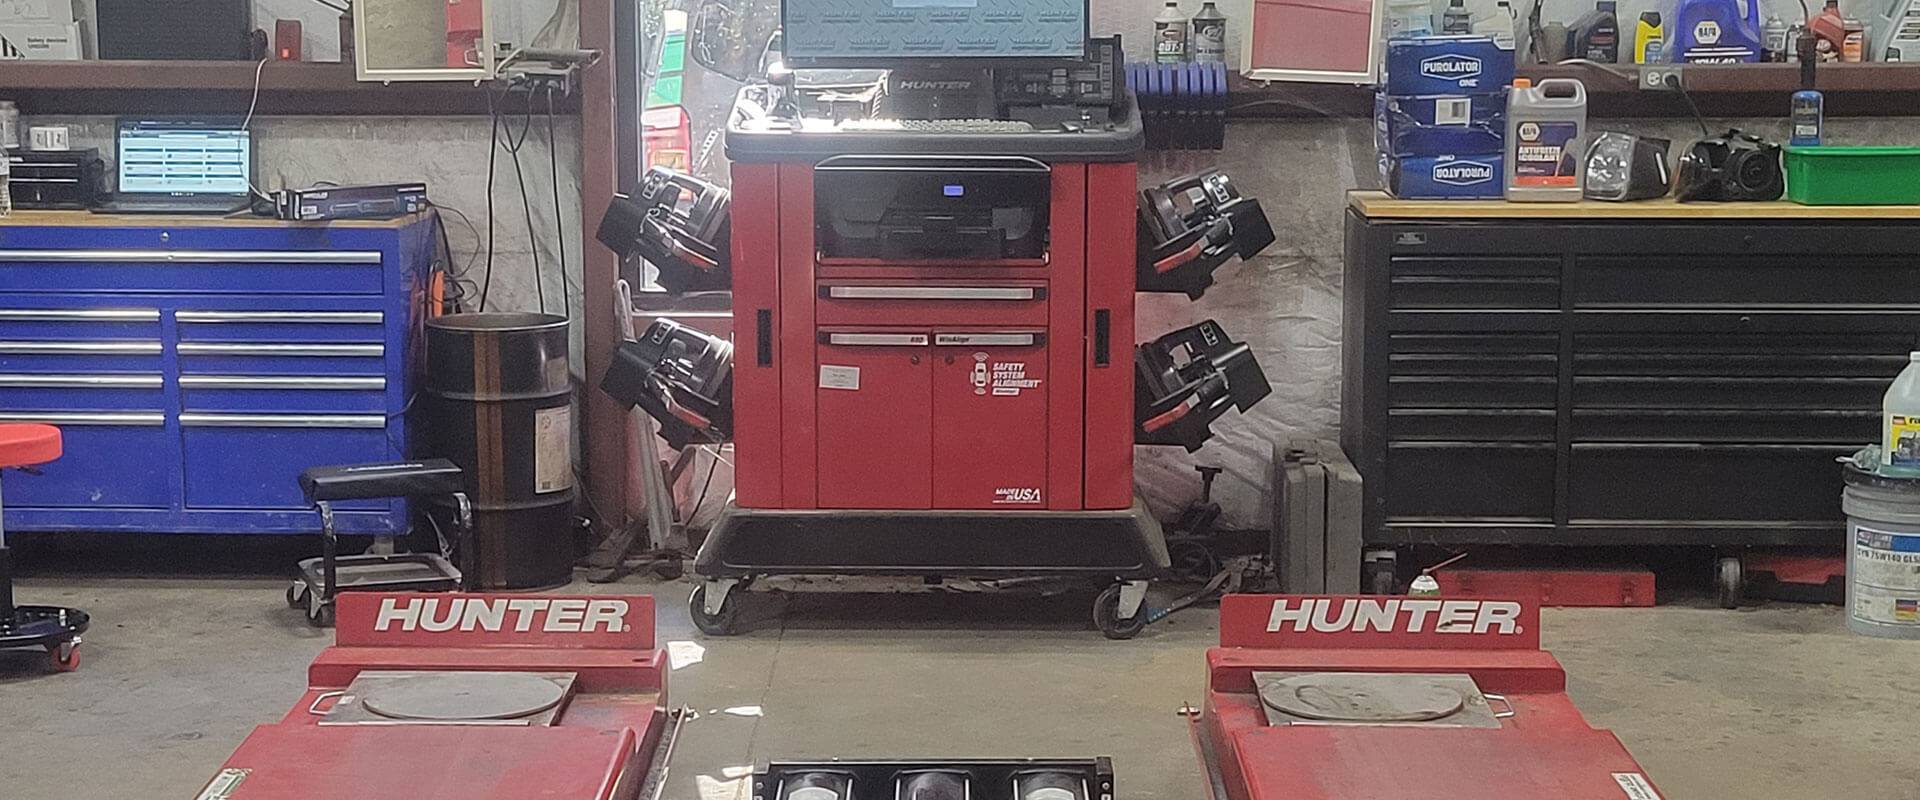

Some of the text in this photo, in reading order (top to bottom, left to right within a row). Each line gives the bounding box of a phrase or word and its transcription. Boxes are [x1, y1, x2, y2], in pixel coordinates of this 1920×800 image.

[1424, 61, 1478, 73] PUROLATOR
[901, 81, 971, 89] HUNTER
[1459, 79, 1479, 87] ONE
[1519, 146, 1560, 154] ANTIFREEZE
[1436, 168, 1490, 178] PUROLATOR
[993, 363, 1025, 371] SAFETY
[993, 371, 1026, 379] SYSTEM
[992, 380, 1039, 388] ALIGNMENT
[1014, 488, 1041, 500] USA
[375, 599, 628, 632] HUNTER
[1266, 599, 1521, 634] HUNTER
